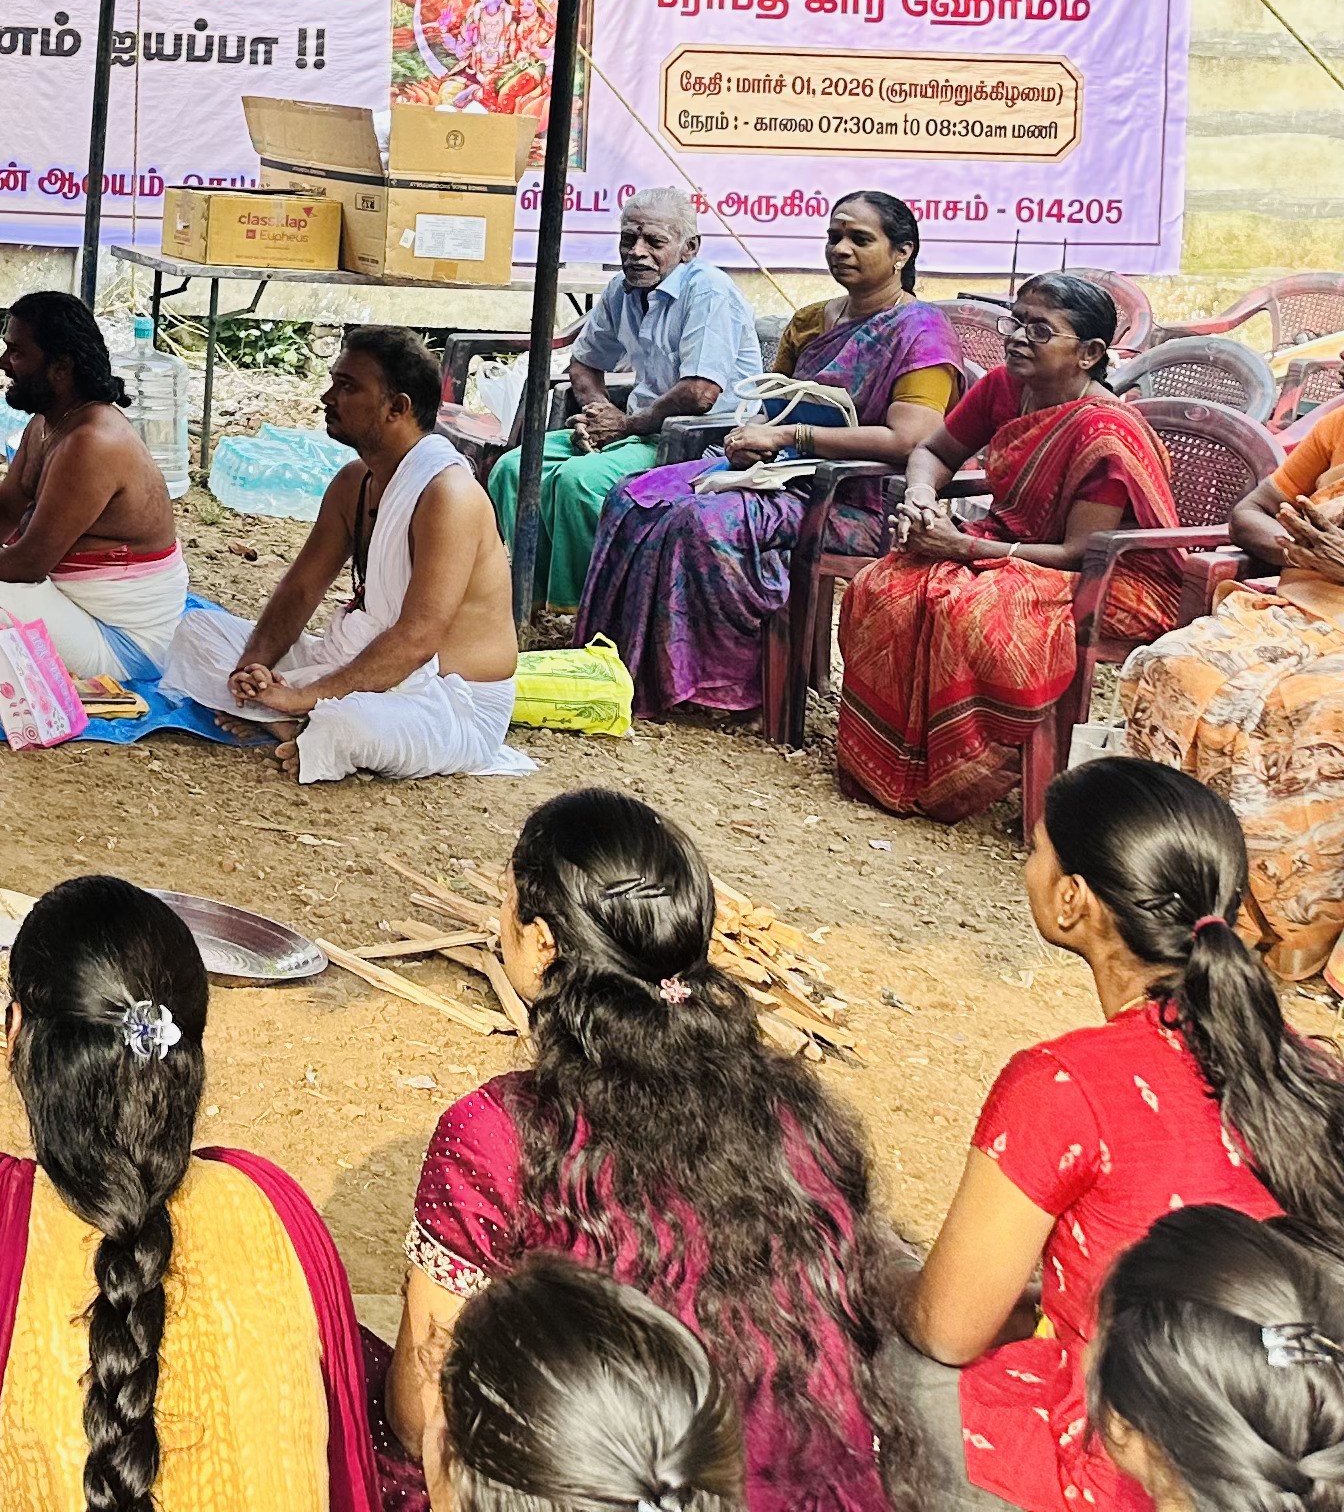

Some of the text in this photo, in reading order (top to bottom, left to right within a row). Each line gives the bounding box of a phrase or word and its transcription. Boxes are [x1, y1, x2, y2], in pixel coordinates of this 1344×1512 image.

[110, 18, 280, 68] ஐயப்பா
[680, 70, 723, 97] தேதி
[737, 74, 788, 95] மார்ச்
[821, 77, 874, 98] 2026
[878, 77, 1064, 108] (ஞாயிற்றுக்கிழமை)
[678, 110, 729, 133] நேரம்
[754, 115, 814, 133] காலை
[818, 116, 899, 136] 07:30am
[903, 112, 920, 136] to
[925, 117, 1008, 139] 08:30am
[1012, 120, 1058, 140] மணி
[238, 212, 308, 231] classlap
[716, 189, 830, 223] அருகில்
[1015, 197, 1123, 225] 614205
[260, 230, 309, 243] Eupheus
